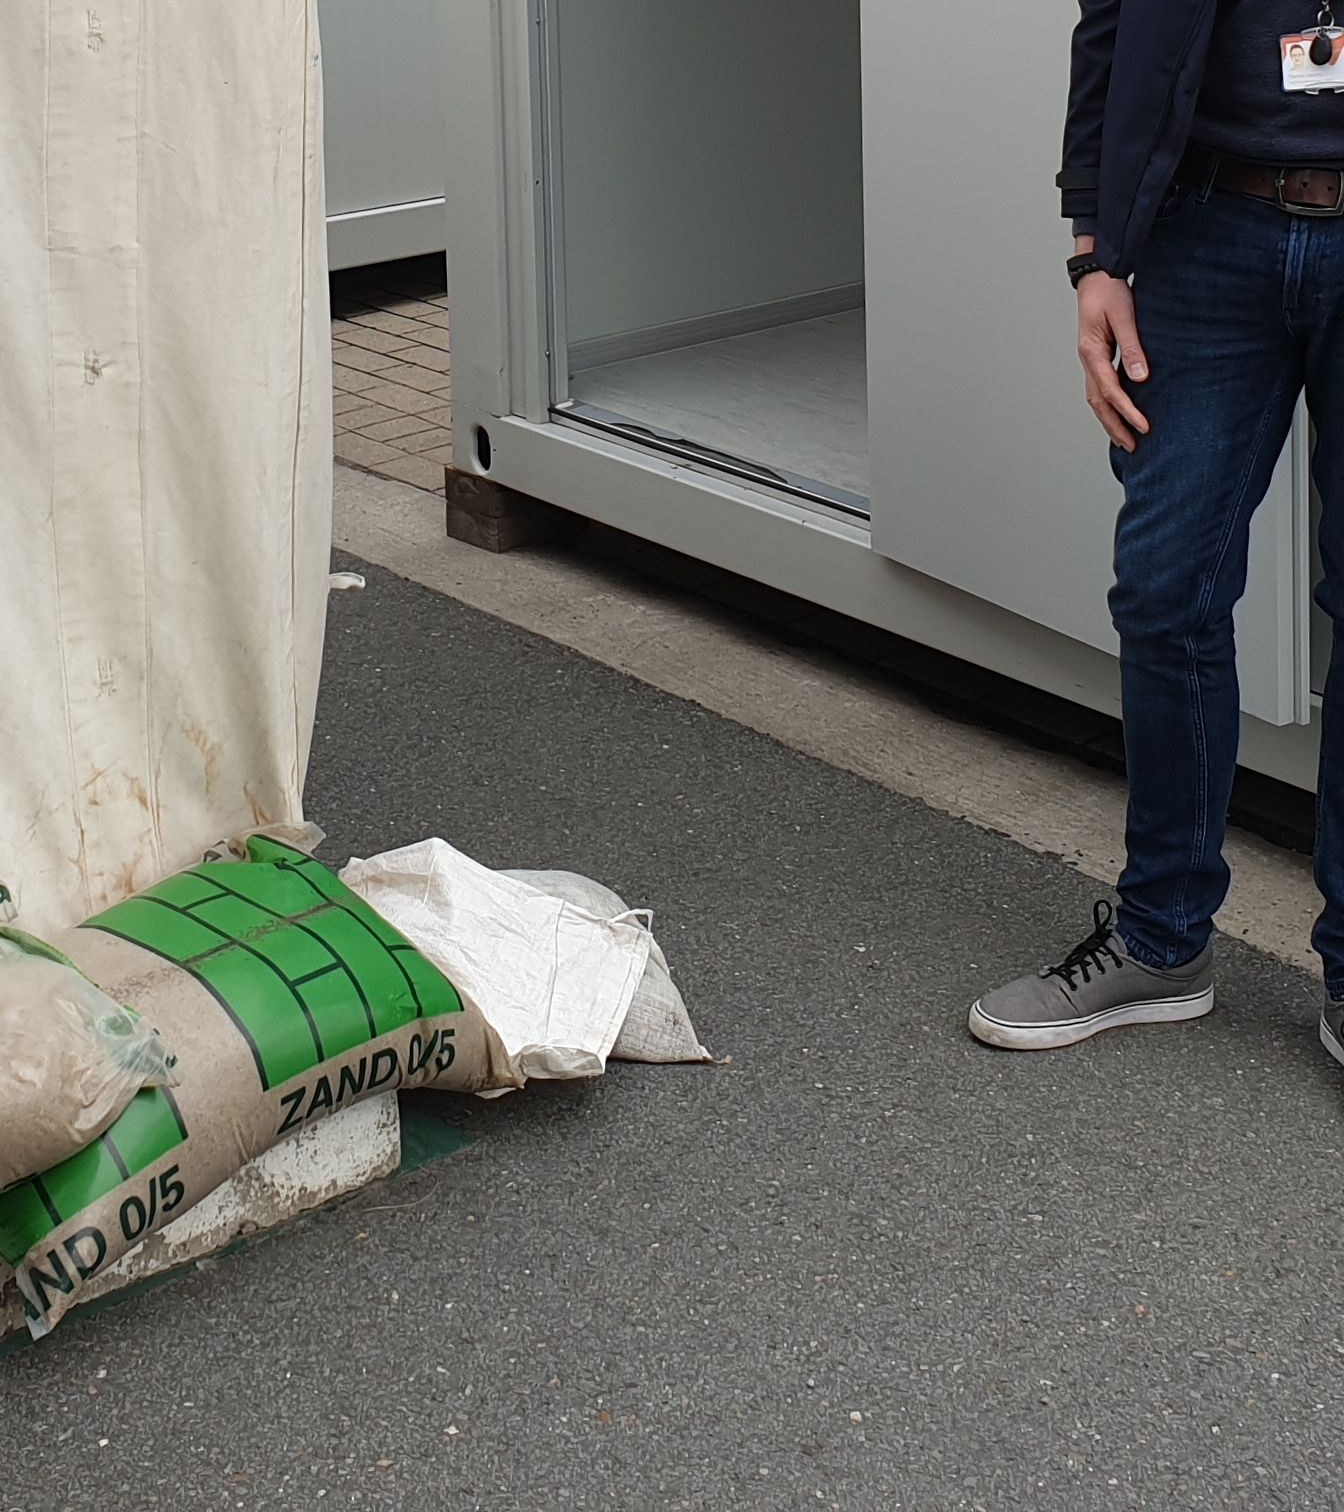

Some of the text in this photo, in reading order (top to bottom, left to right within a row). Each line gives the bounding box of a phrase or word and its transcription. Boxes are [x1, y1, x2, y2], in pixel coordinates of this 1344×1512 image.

[278, 1028, 456, 1135] ZAND 0/5
[119, 1163, 185, 1241] 0/5
